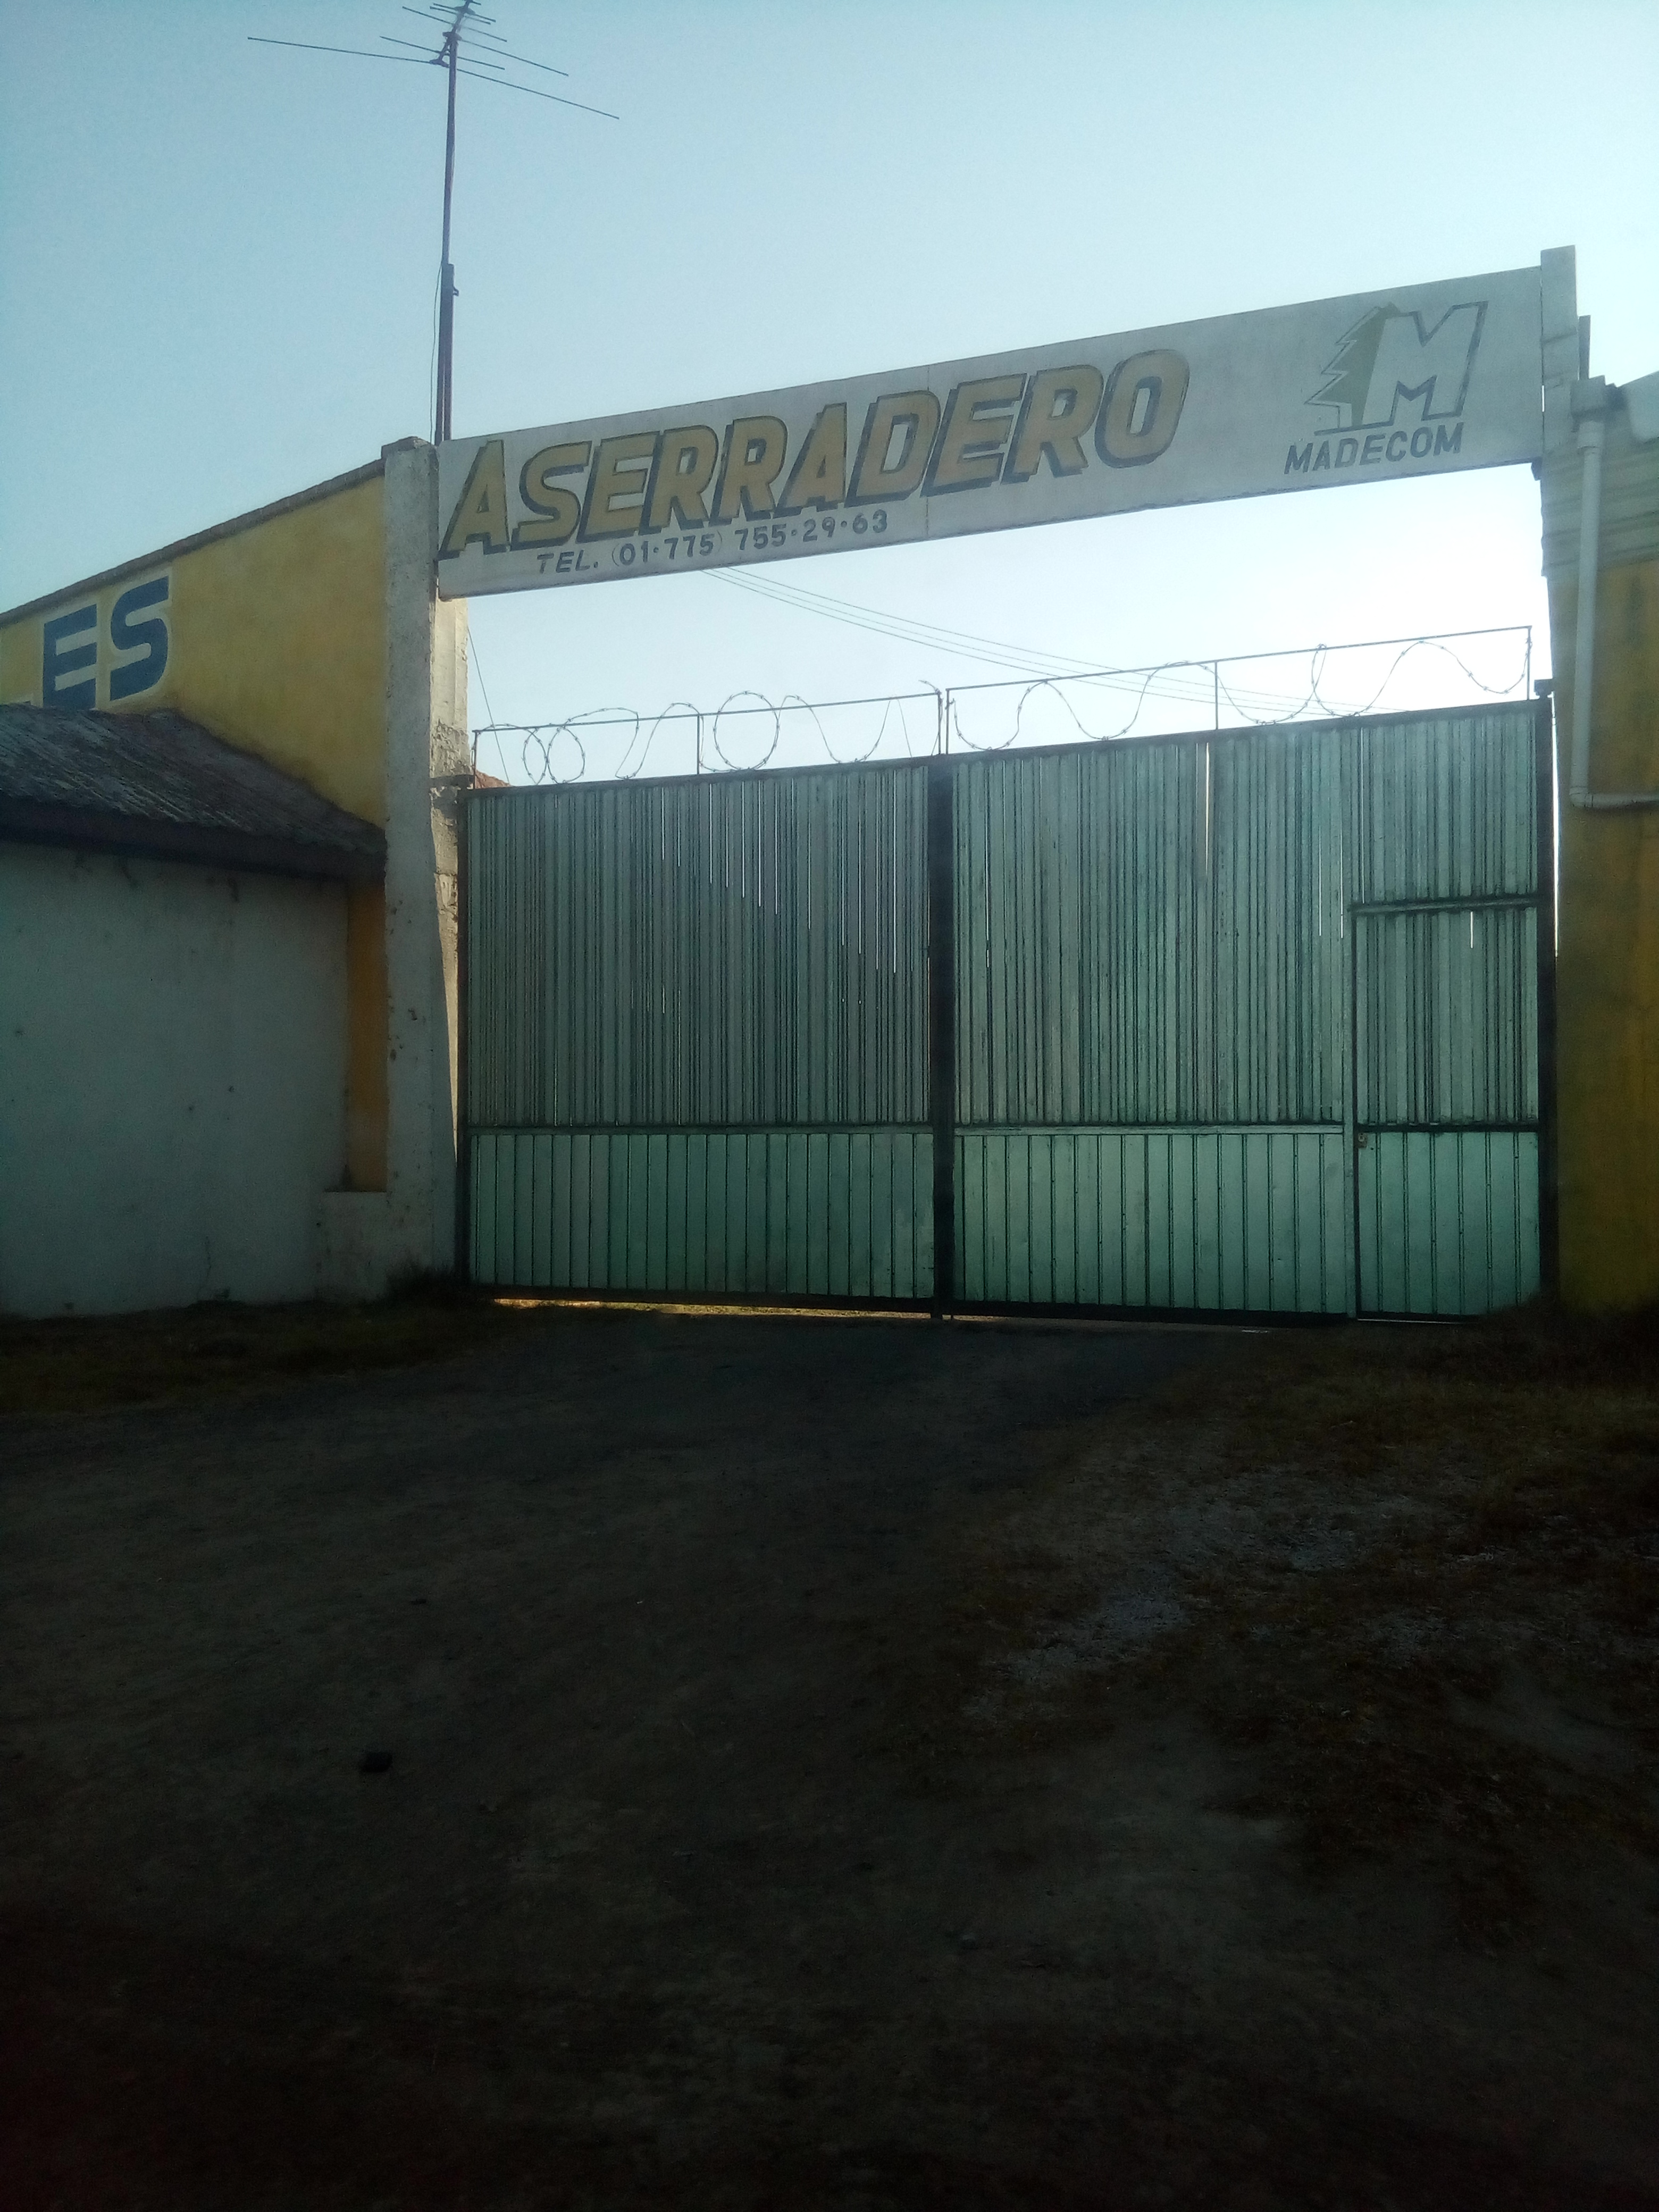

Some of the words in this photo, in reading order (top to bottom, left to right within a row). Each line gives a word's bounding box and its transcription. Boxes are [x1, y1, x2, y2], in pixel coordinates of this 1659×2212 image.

[437, 349, 1191, 560] ASERRADERO
[1284, 422, 1464, 474] MADECOM
[537, 549, 599, 574] TEL.
[43, 575, 169, 710] ES
